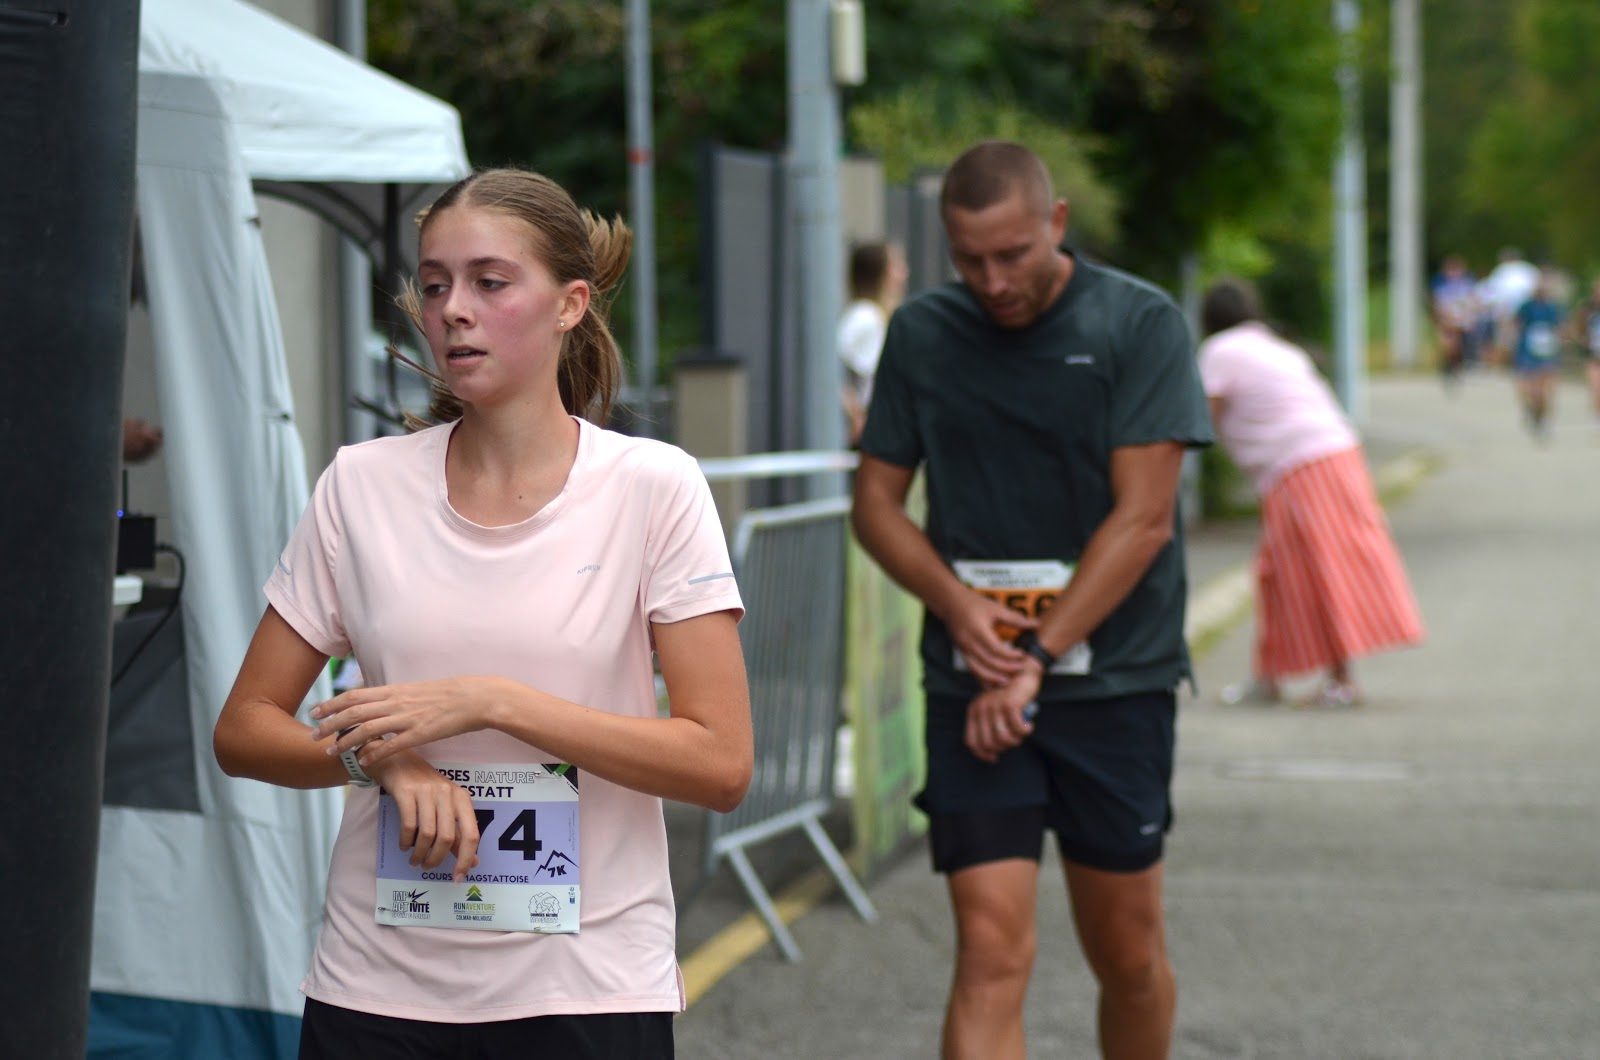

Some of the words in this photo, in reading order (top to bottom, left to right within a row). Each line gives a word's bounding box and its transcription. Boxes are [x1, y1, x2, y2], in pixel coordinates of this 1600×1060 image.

[474, 770, 535, 784] NATURE
[460, 785, 514, 798] STATT
[421, 871, 453, 881] COURS
[547, 864, 567, 878] 7K
